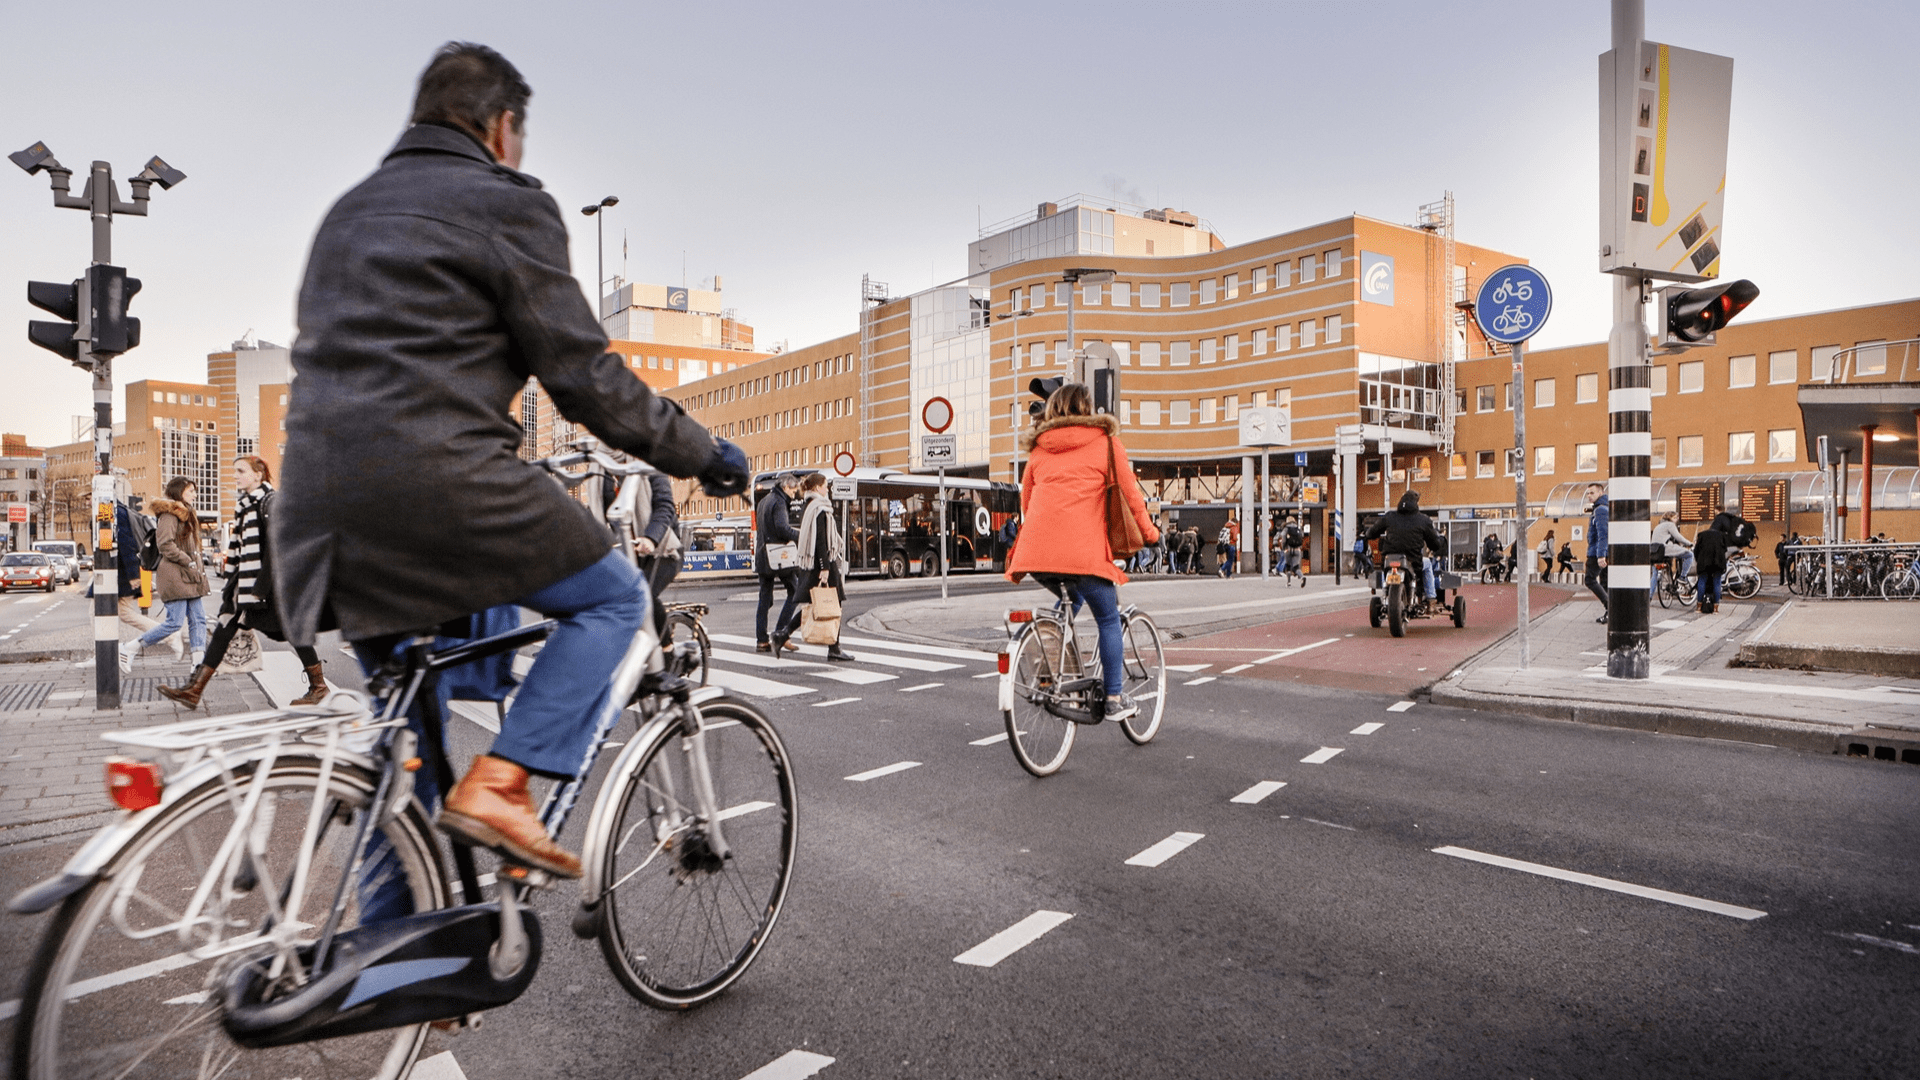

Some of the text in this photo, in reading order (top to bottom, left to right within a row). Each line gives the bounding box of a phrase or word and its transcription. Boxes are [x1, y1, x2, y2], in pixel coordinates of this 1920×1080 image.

[1635, 196, 1645, 213] D
[923, 437, 954, 445] Uitgezonderd
[975, 506, 991, 537] Q
